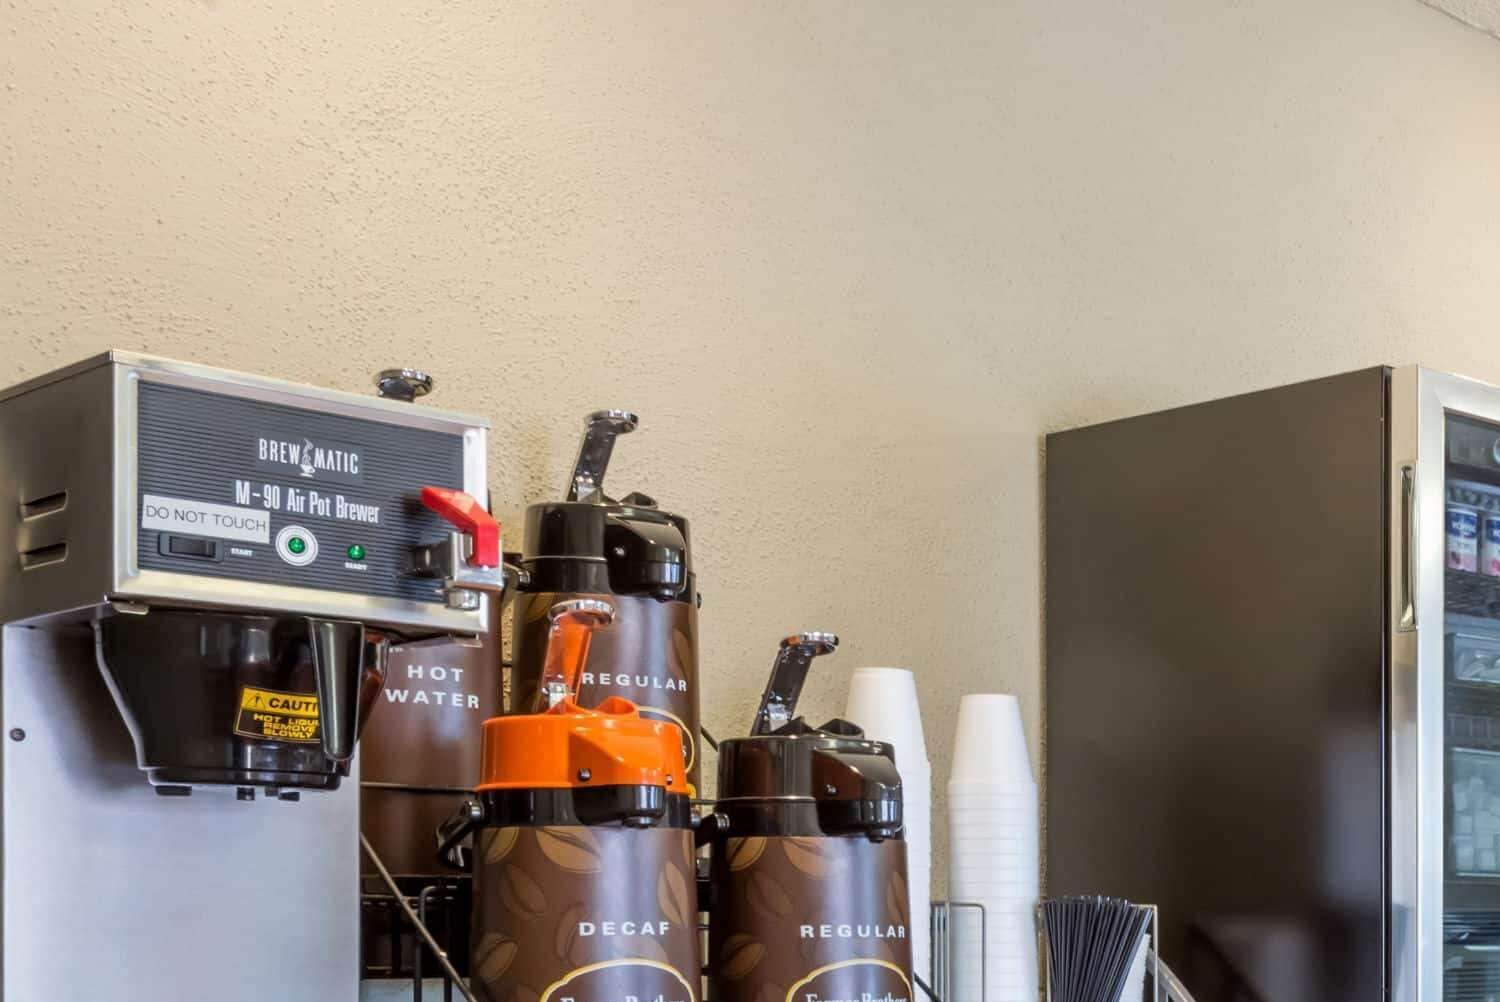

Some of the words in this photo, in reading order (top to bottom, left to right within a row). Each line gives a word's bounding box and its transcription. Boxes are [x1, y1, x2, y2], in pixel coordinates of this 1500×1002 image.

[259, 438, 300, 465] BREW
[314, 447, 359, 474] MATIC
[288, 488, 306, 513] Air
[310, 491, 331, 517] Pot
[336, 495, 380, 523] Brewer
[146, 505, 169, 520] DO
[174, 508, 207, 525] NOT
[213, 513, 267, 532] TOUCH
[407, 664, 464, 683] HOT
[581, 672, 688, 692] REGULAR
[385, 688, 480, 710] WATER
[578, 920, 670, 937] DECAF
[800, 924, 906, 938] REGULAR
